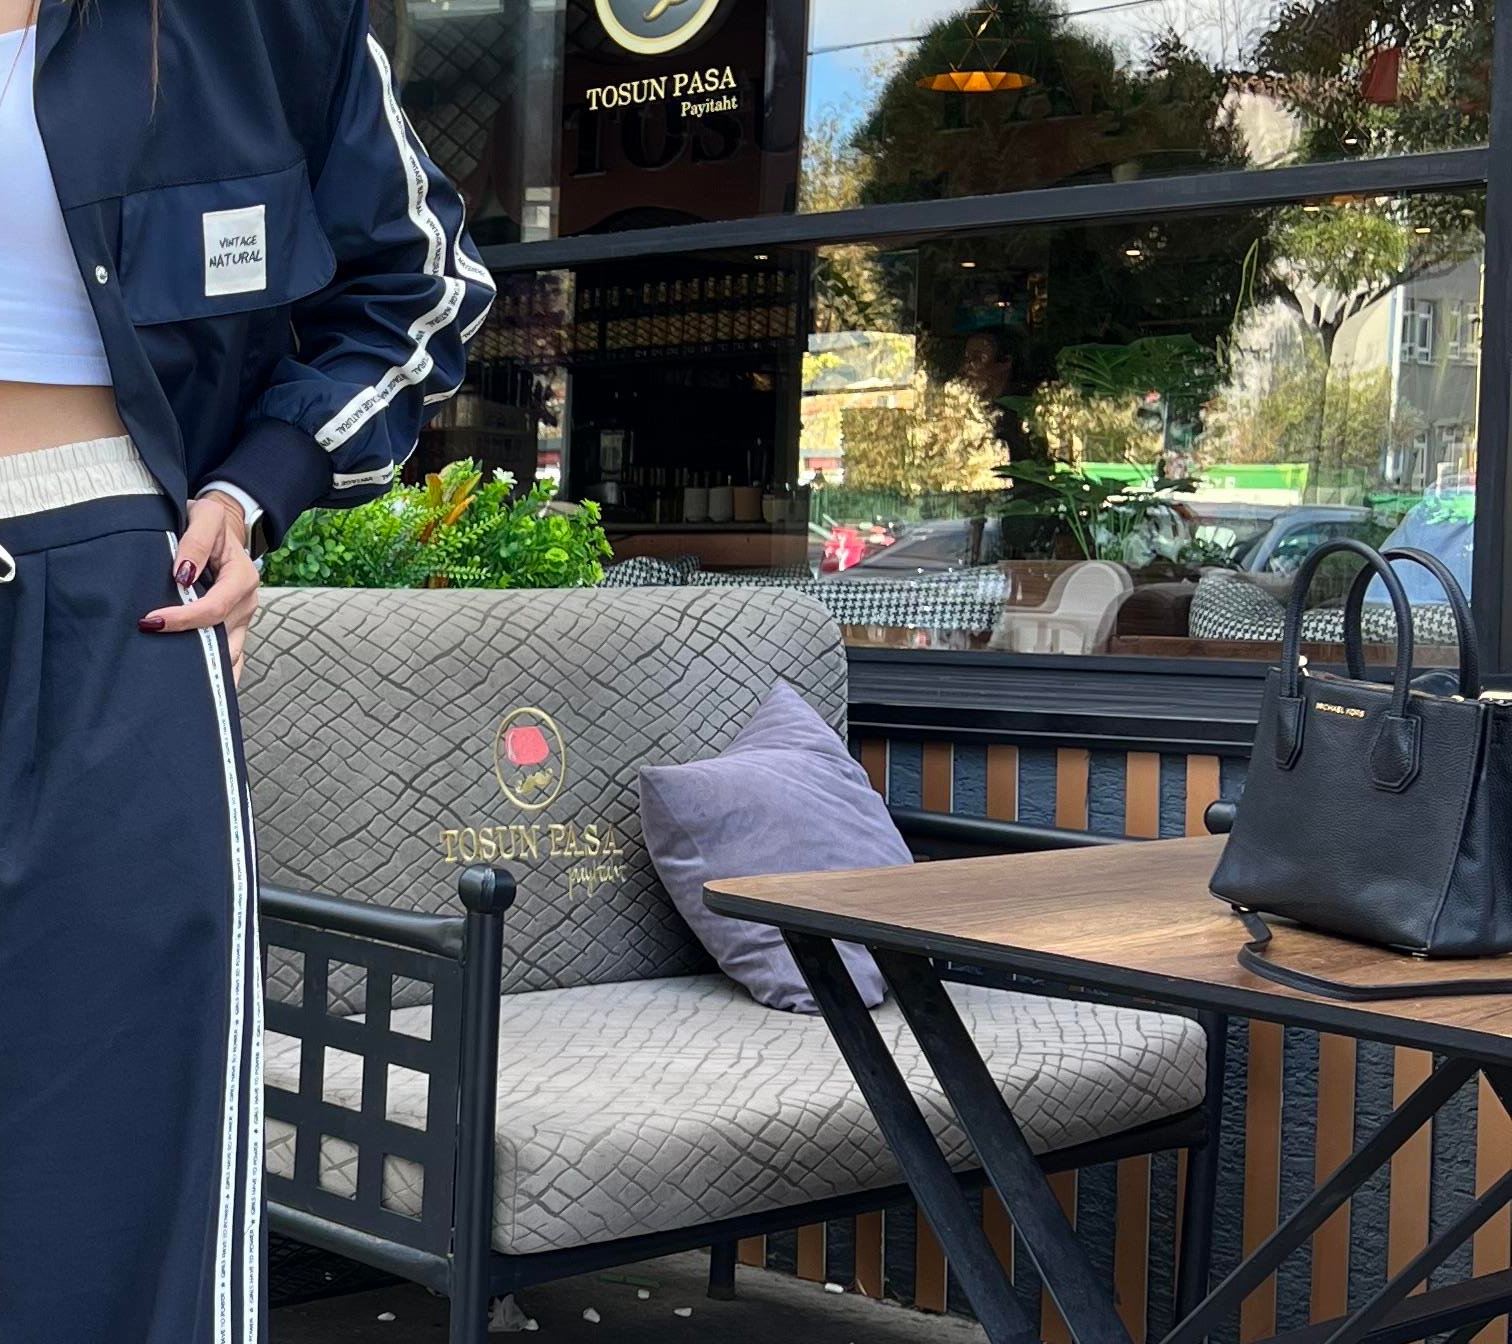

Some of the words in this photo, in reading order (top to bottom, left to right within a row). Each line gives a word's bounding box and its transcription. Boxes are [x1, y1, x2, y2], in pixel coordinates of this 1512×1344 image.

[586, 76, 668, 111] TOSUN
[680, 95, 738, 118] Payitaht
[219, 234, 257, 248] VINTAGE
[209, 249, 263, 268] NATURAL
[335, 409, 365, 435] NATURAL
[440, 824, 540, 863] TOSUN
